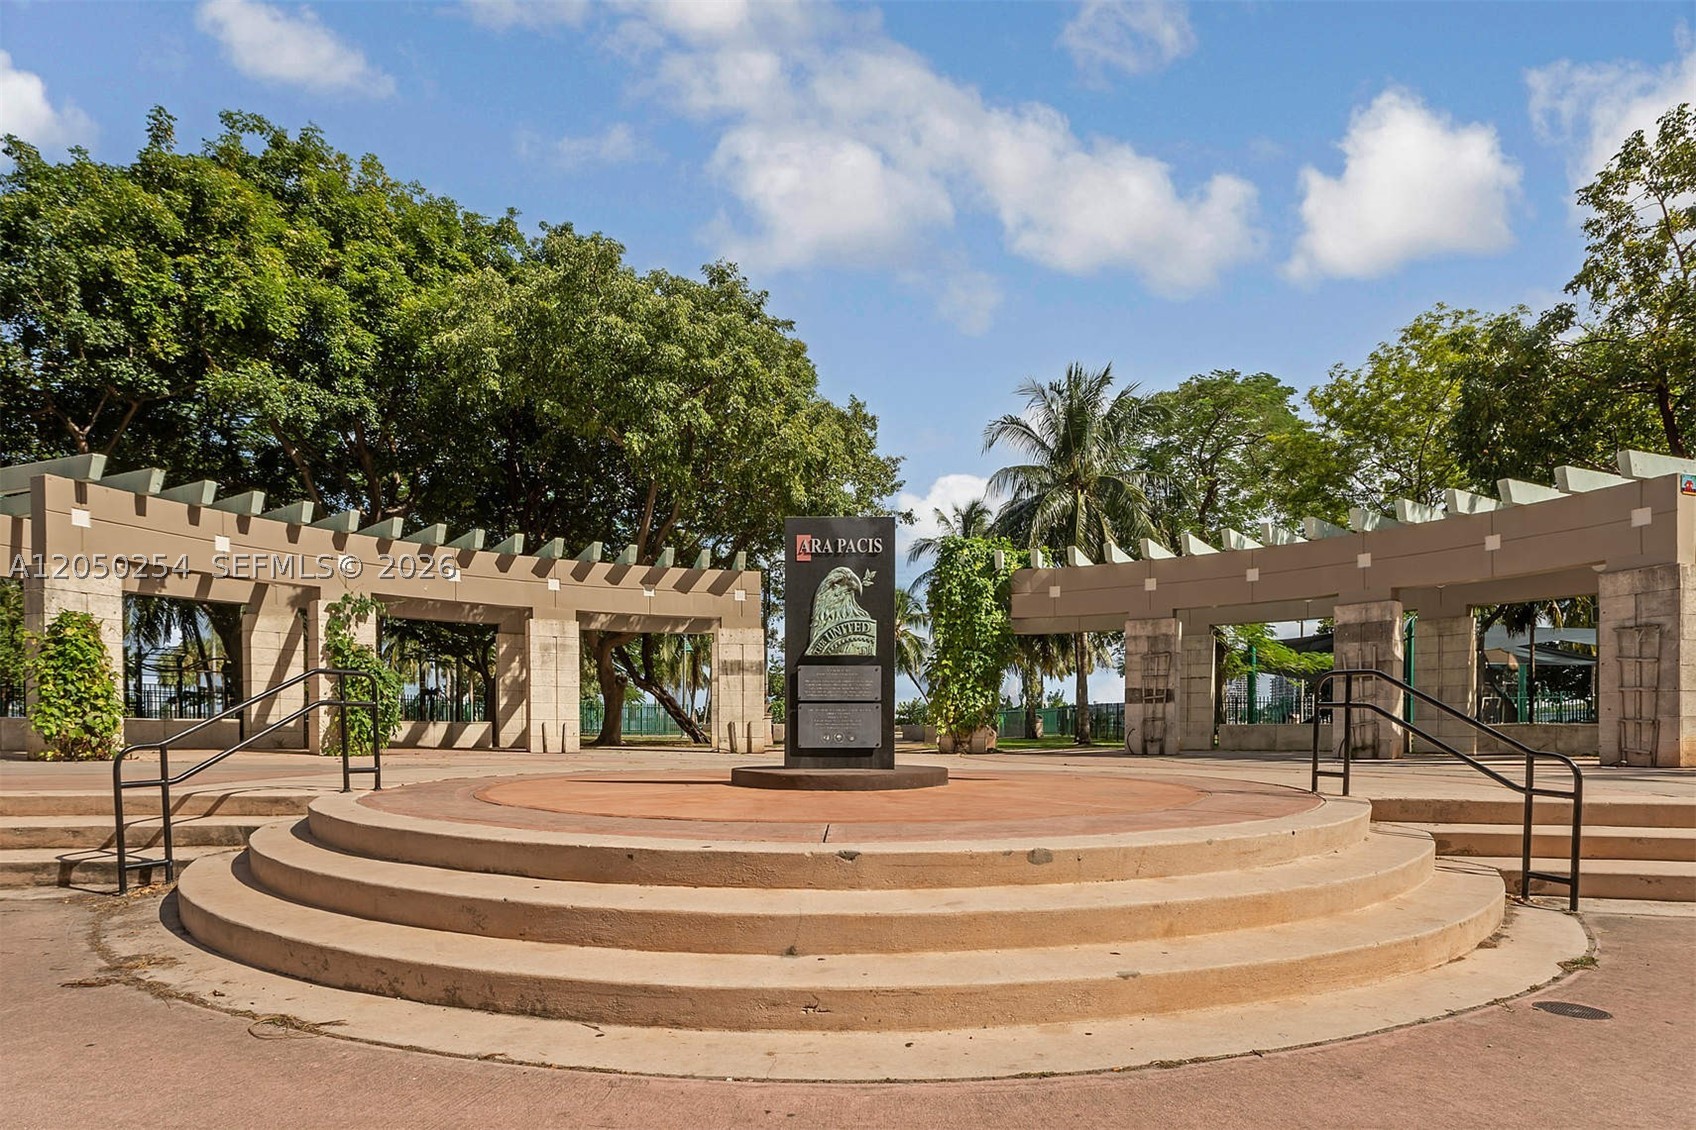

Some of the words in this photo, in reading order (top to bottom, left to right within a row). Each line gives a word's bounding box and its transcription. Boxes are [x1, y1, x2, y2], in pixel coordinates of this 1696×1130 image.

[799, 537, 833, 554] ARA
[838, 537, 883, 554] PACIS
[813, 637, 829, 655] THE
[824, 621, 871, 642] UNITED
